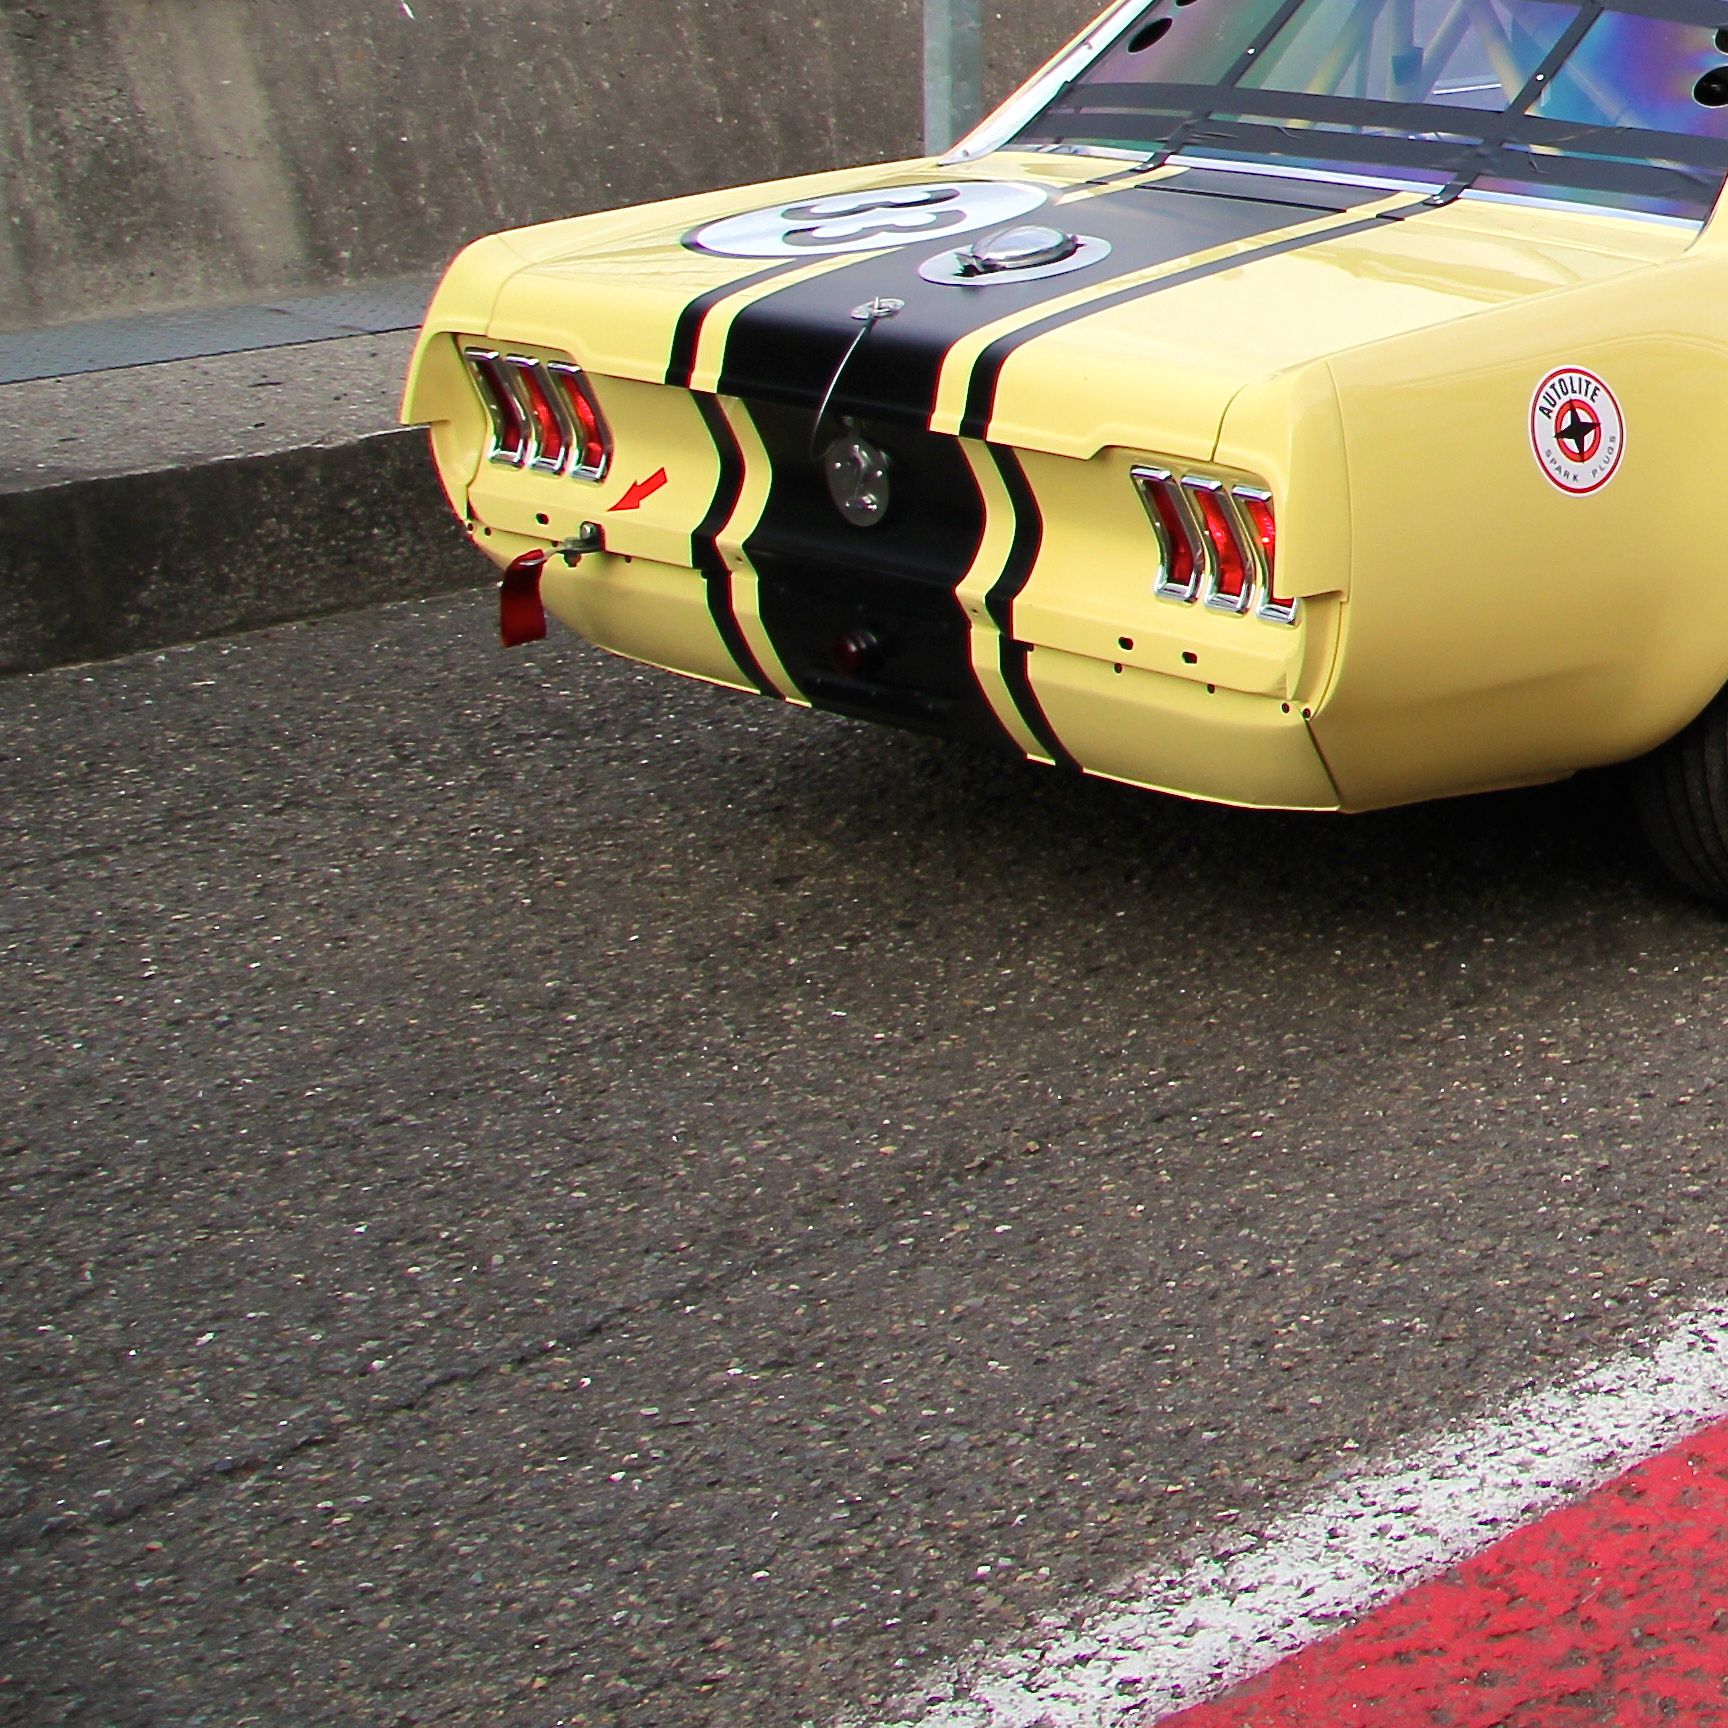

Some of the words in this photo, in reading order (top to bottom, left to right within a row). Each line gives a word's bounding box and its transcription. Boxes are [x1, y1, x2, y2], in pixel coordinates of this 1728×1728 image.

[1538, 375, 1601, 419] AUTOLITE
[1544, 448, 1579, 482] SPARK
[1591, 435, 1616, 479] PLUGS
